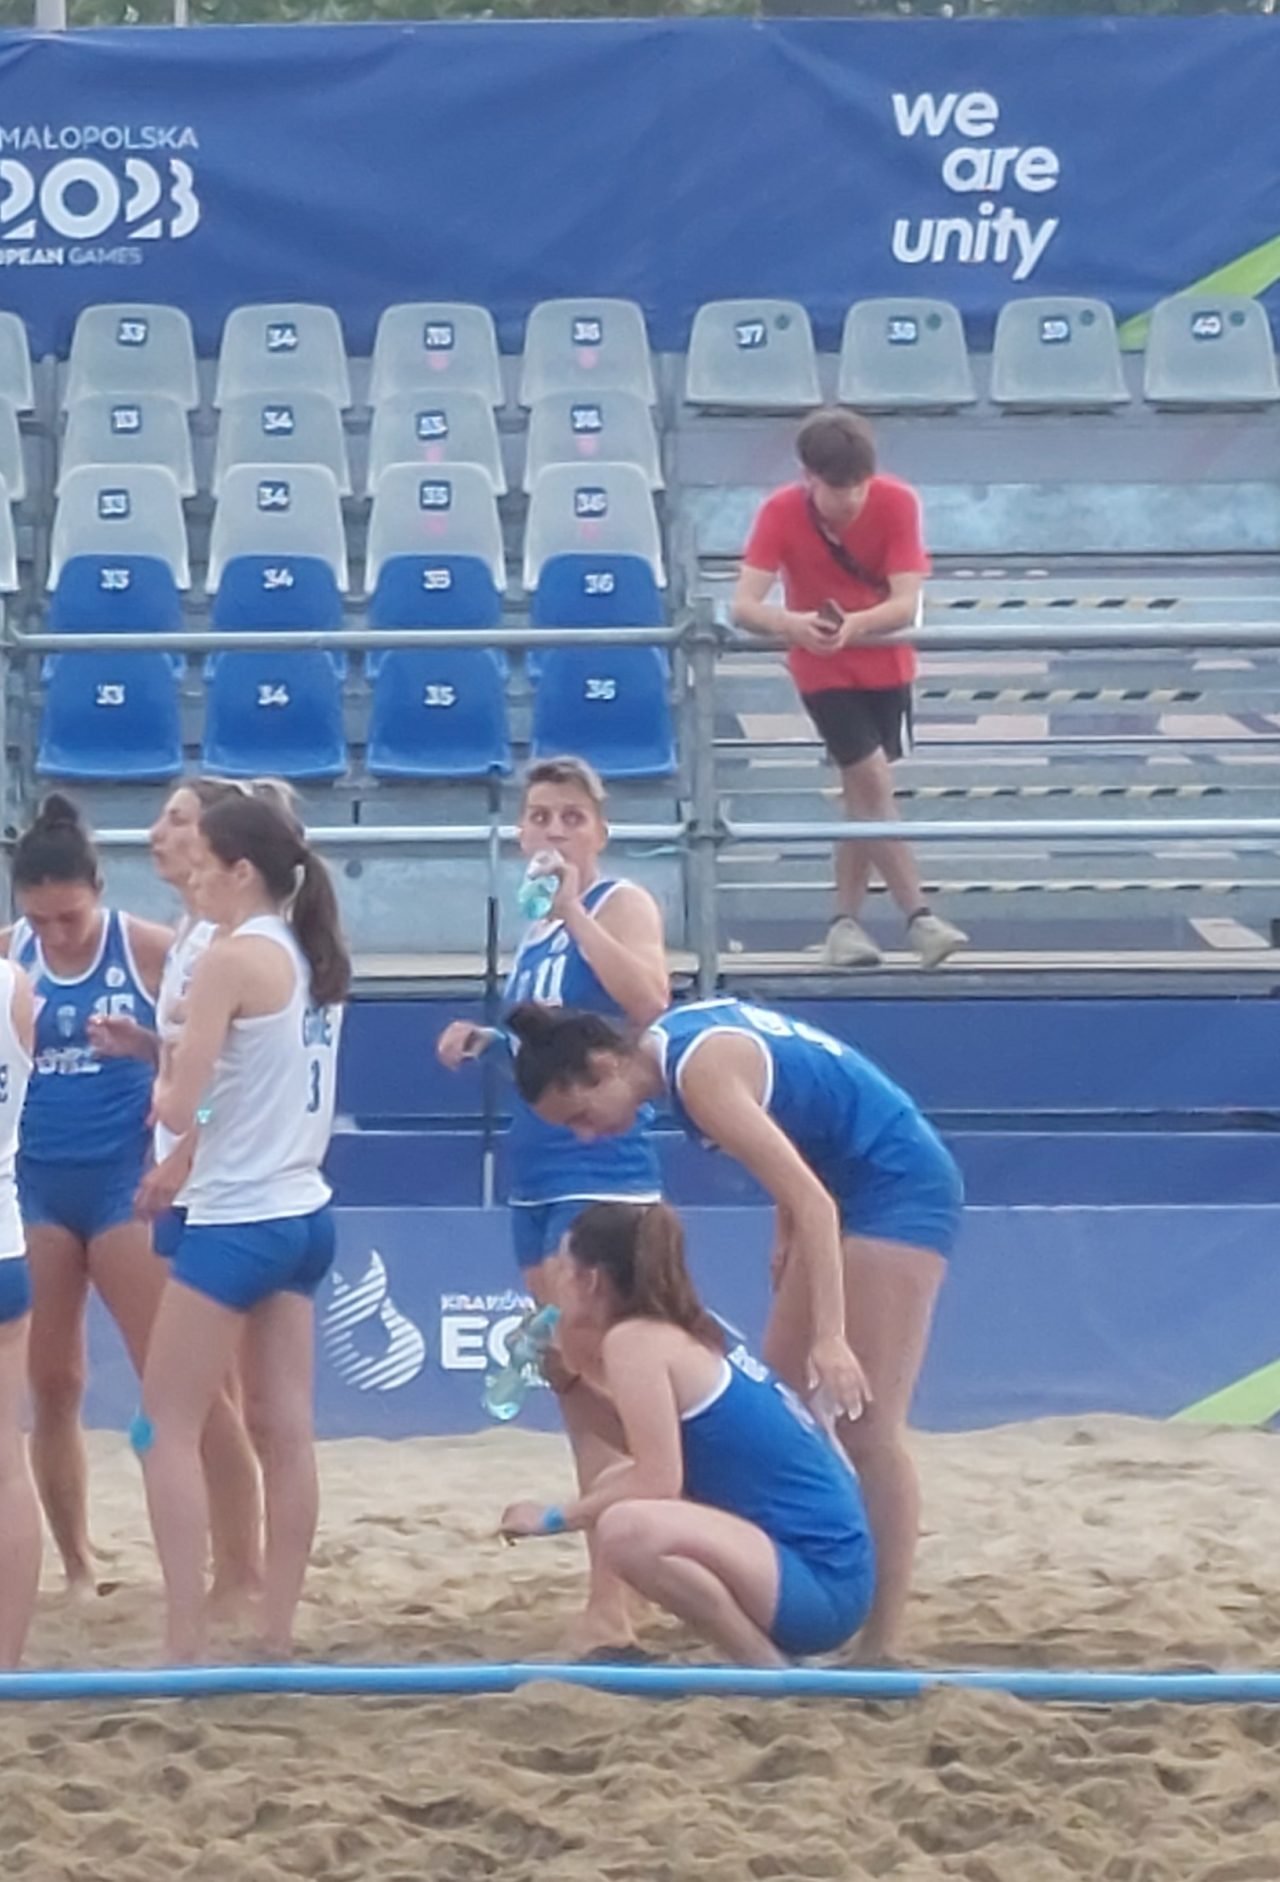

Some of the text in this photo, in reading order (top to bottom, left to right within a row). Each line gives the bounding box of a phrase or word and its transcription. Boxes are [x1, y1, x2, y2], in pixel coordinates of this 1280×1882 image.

[891, 91, 1000, 138] we
[942, 145, 1061, 193] are
[68, 247, 144, 266] GAMES
[892, 201, 1060, 281] unity
